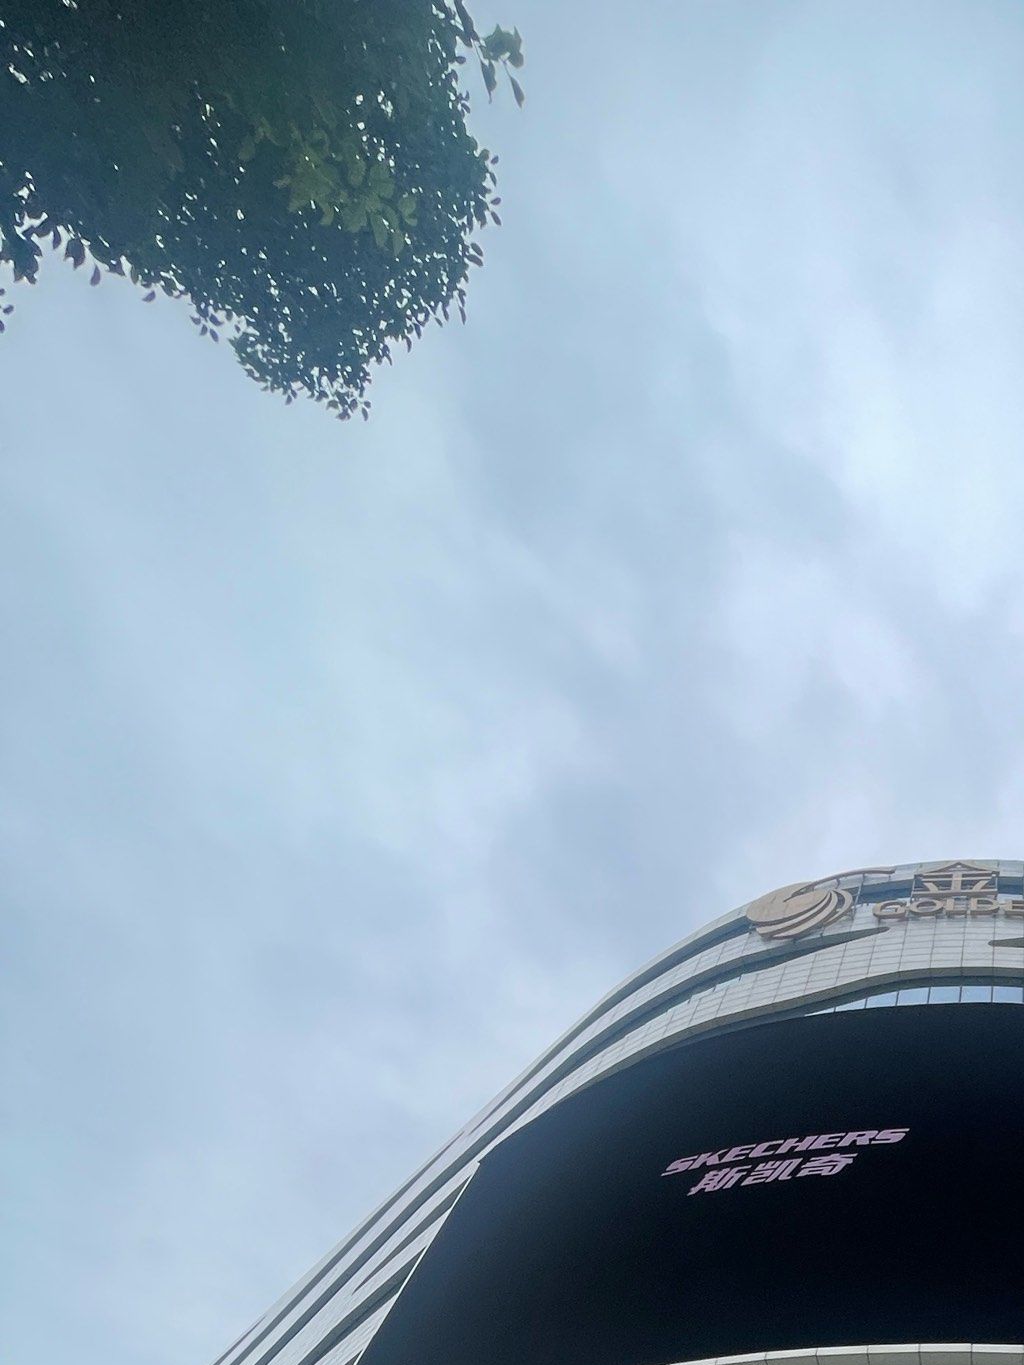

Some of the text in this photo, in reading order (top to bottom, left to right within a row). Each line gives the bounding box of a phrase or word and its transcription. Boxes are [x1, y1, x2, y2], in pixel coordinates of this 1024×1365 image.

[661, 1128, 910, 1176] SKECHERS
[687, 1153, 858, 1196] 斯凯奇
